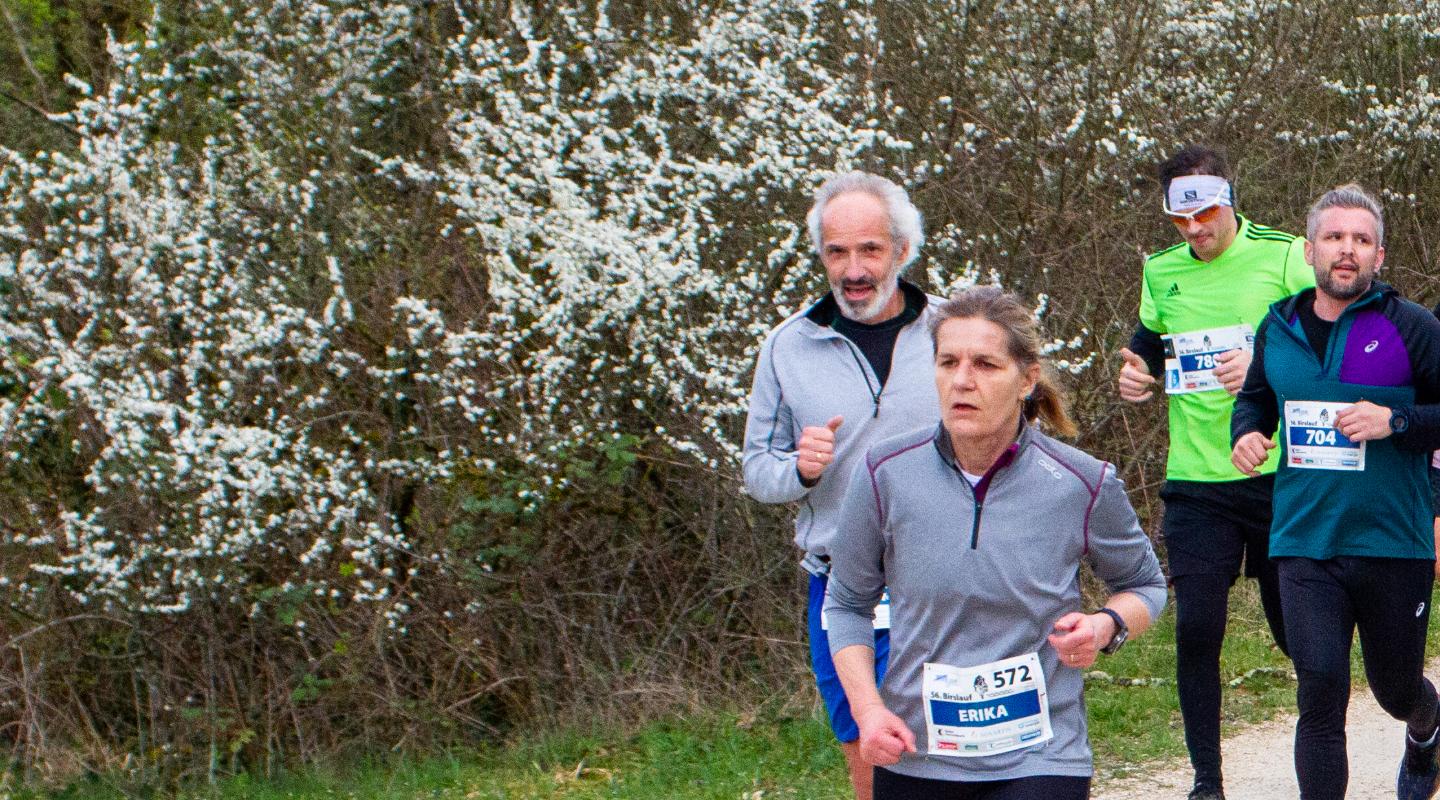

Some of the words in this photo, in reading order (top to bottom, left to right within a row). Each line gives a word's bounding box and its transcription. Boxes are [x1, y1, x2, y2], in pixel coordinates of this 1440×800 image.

[1305, 429, 1337, 446] 704
[993, 665, 1032, 688] 572
[943, 692, 972, 702] Birslauf
[958, 704, 1009, 722] ERIKA
